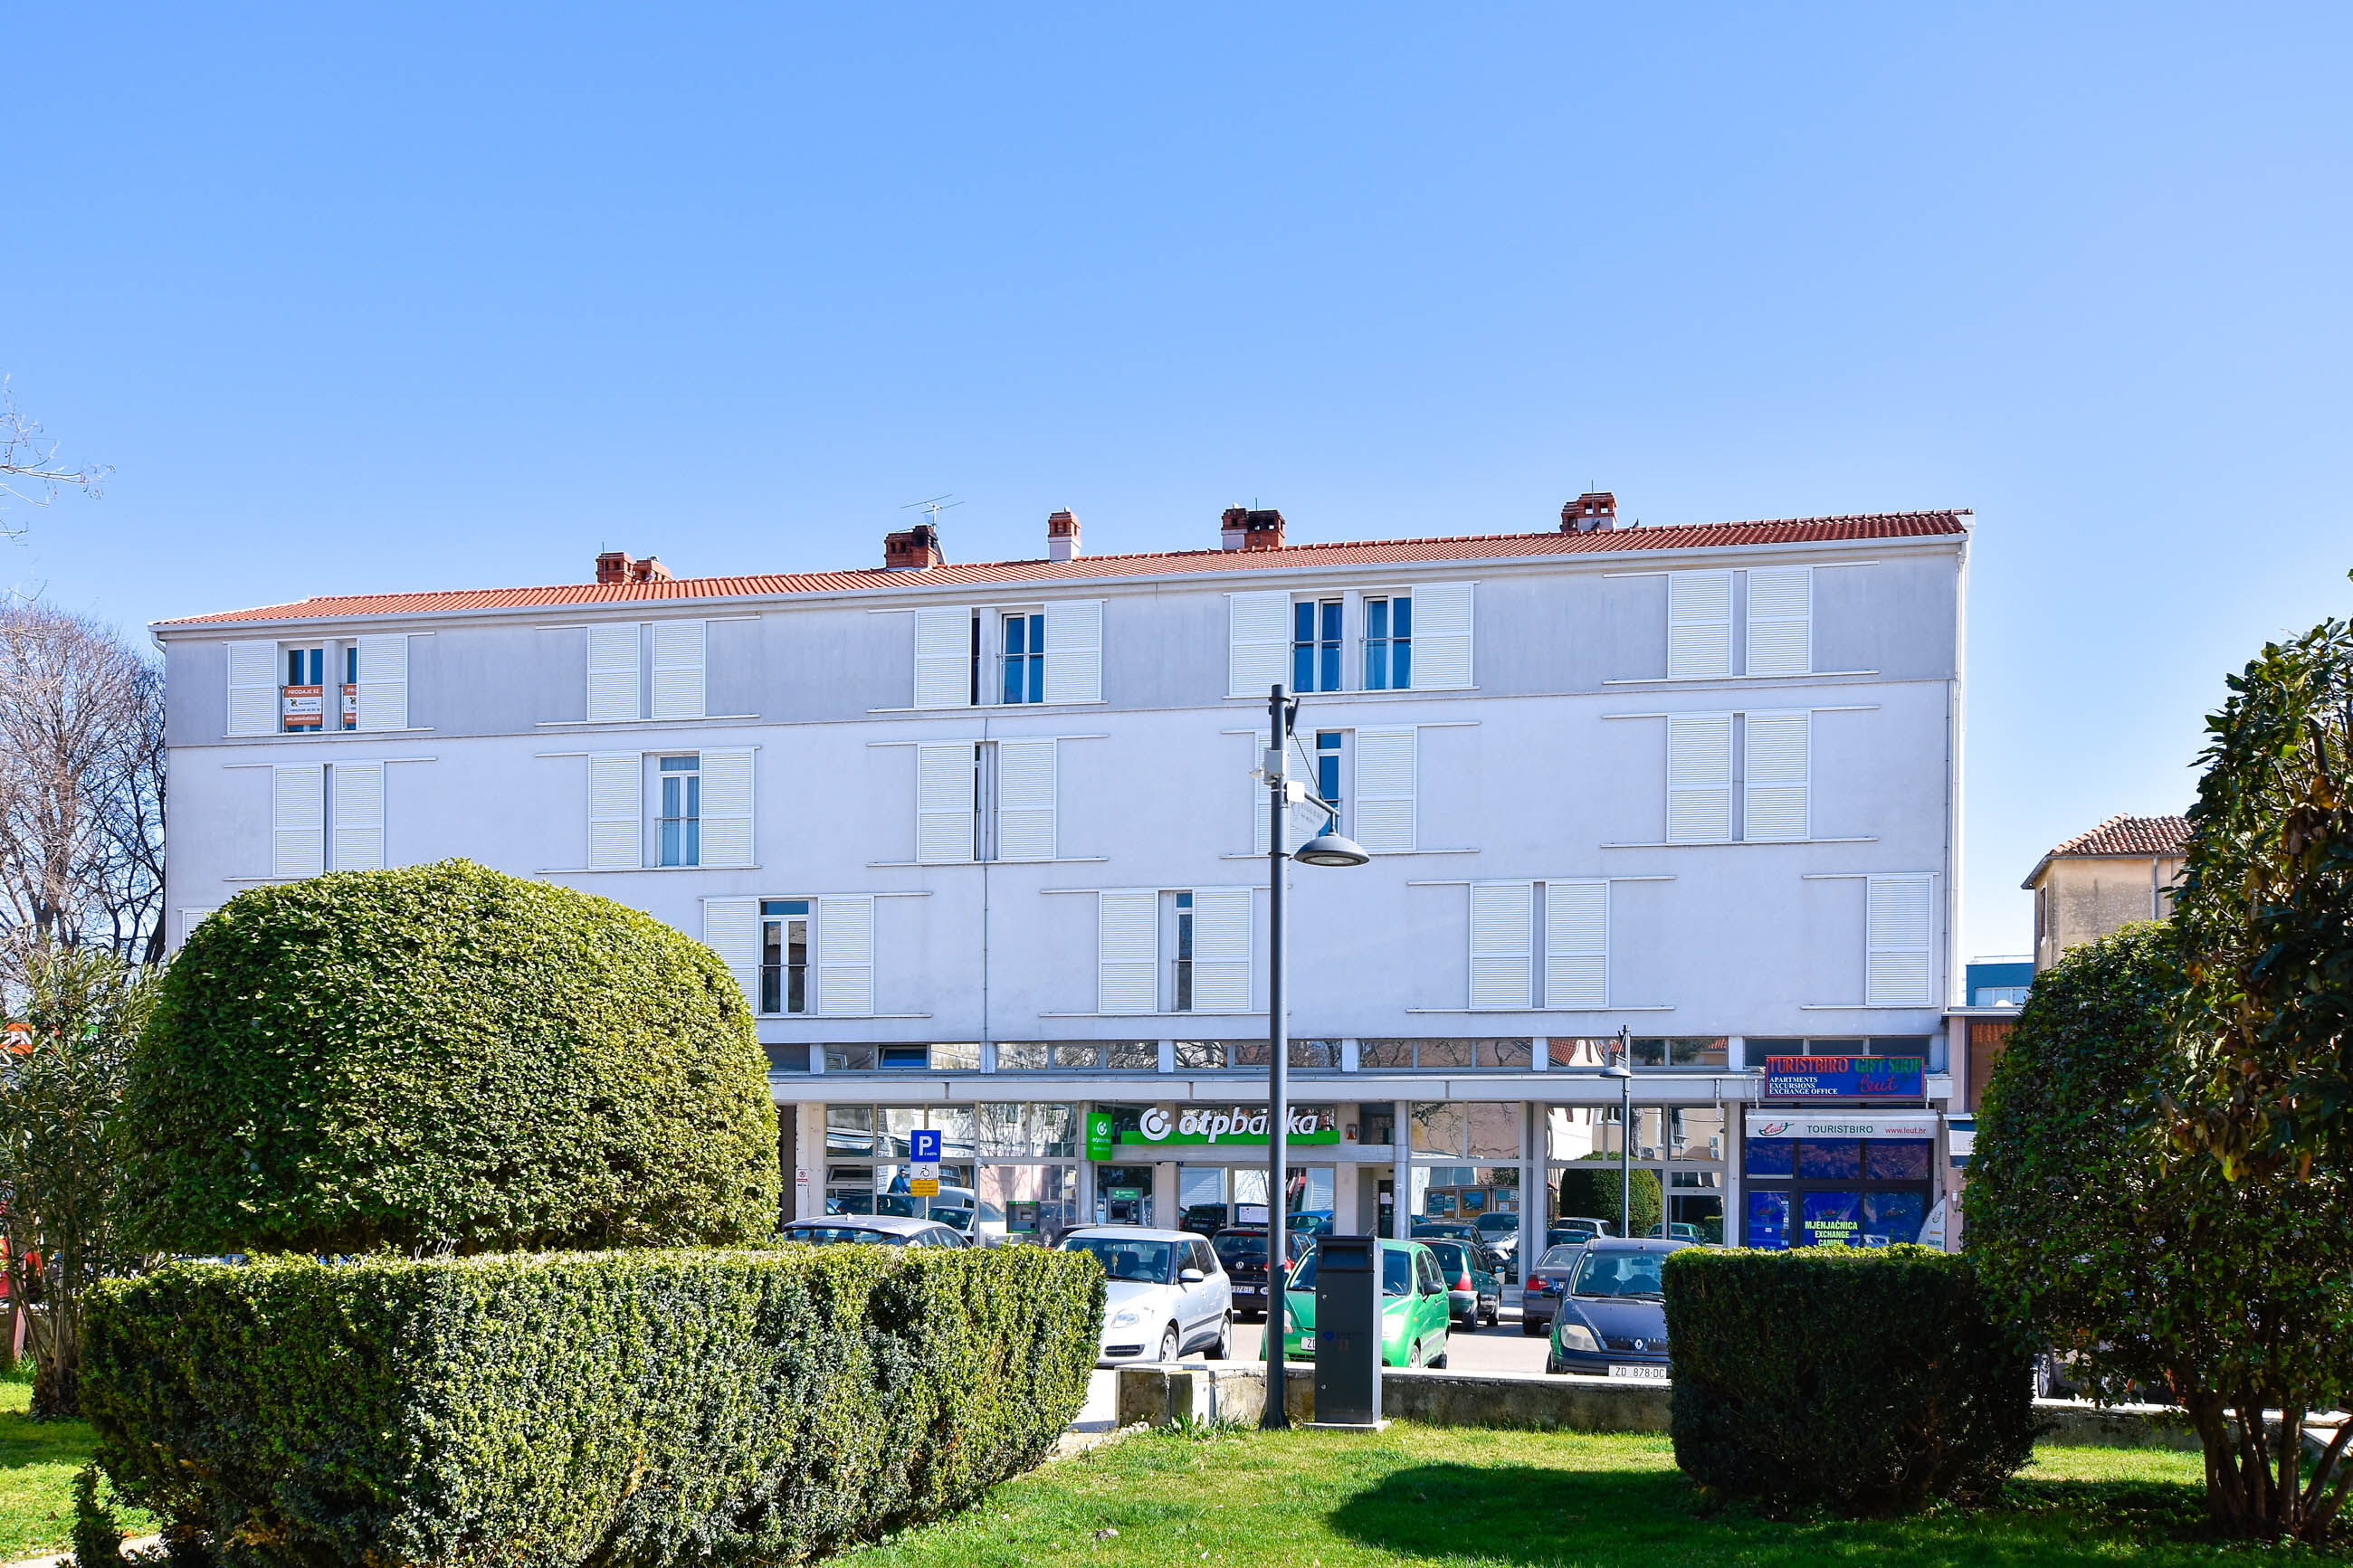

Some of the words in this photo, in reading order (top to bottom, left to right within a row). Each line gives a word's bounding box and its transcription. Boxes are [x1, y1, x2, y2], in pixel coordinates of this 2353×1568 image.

[1768, 1058, 1849, 1074] TURISTBIRO
[1854, 1058, 1887, 1073] GIFT
[1888, 1057, 1923, 1073] SHOP
[1179, 1107, 1319, 1144] otpbaka
[1806, 1125, 1873, 1135] TOURISTBIRO
[919, 1136, 933, 1156] P
[1805, 1220, 1858, 1231] MJENJAČNICA
[1815, 1231, 1850, 1239] EXCHANGE
[1615, 1367, 1627, 1376] ZD
